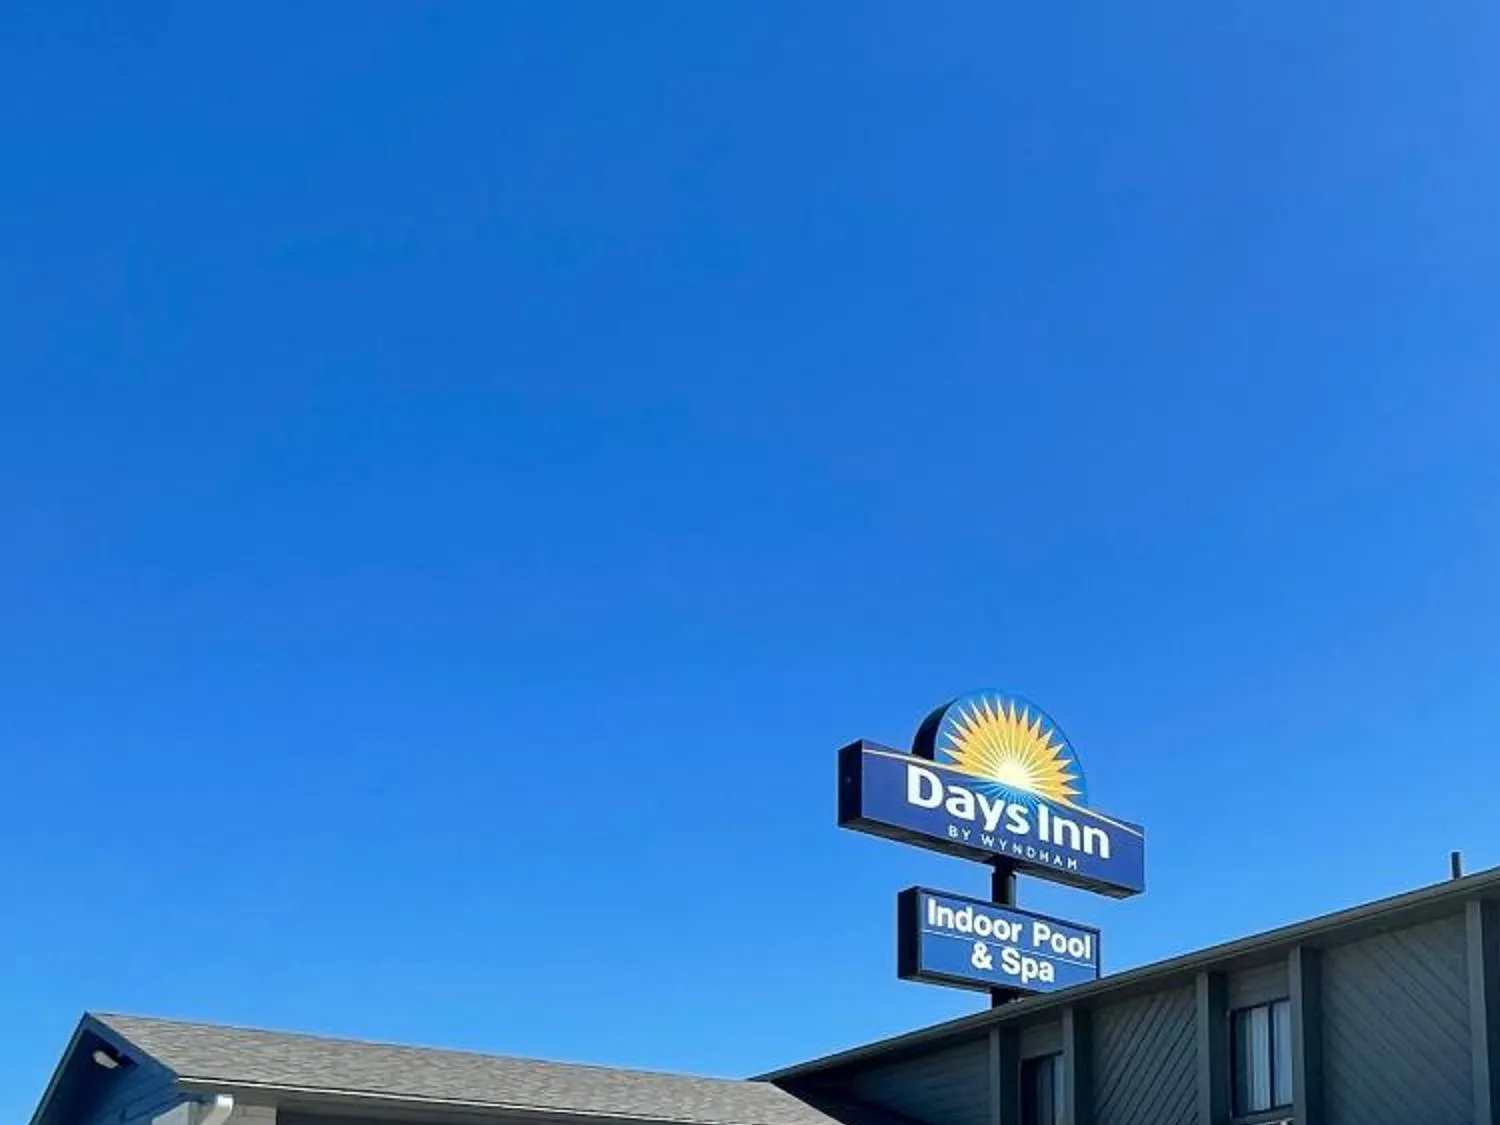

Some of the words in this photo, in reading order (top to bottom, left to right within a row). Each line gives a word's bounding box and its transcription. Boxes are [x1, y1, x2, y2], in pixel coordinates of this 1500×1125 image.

[907, 764, 1030, 835] Days
[1039, 805, 1111, 860] Inn
[948, 824, 971, 841] BY
[981, 834, 1078, 870] WYNDHAM
[927, 898, 1023, 943] Indoor
[1033, 921, 1092, 960] Pool
[971, 942, 993, 970] &
[1001, 947, 1055, 984] Spa
